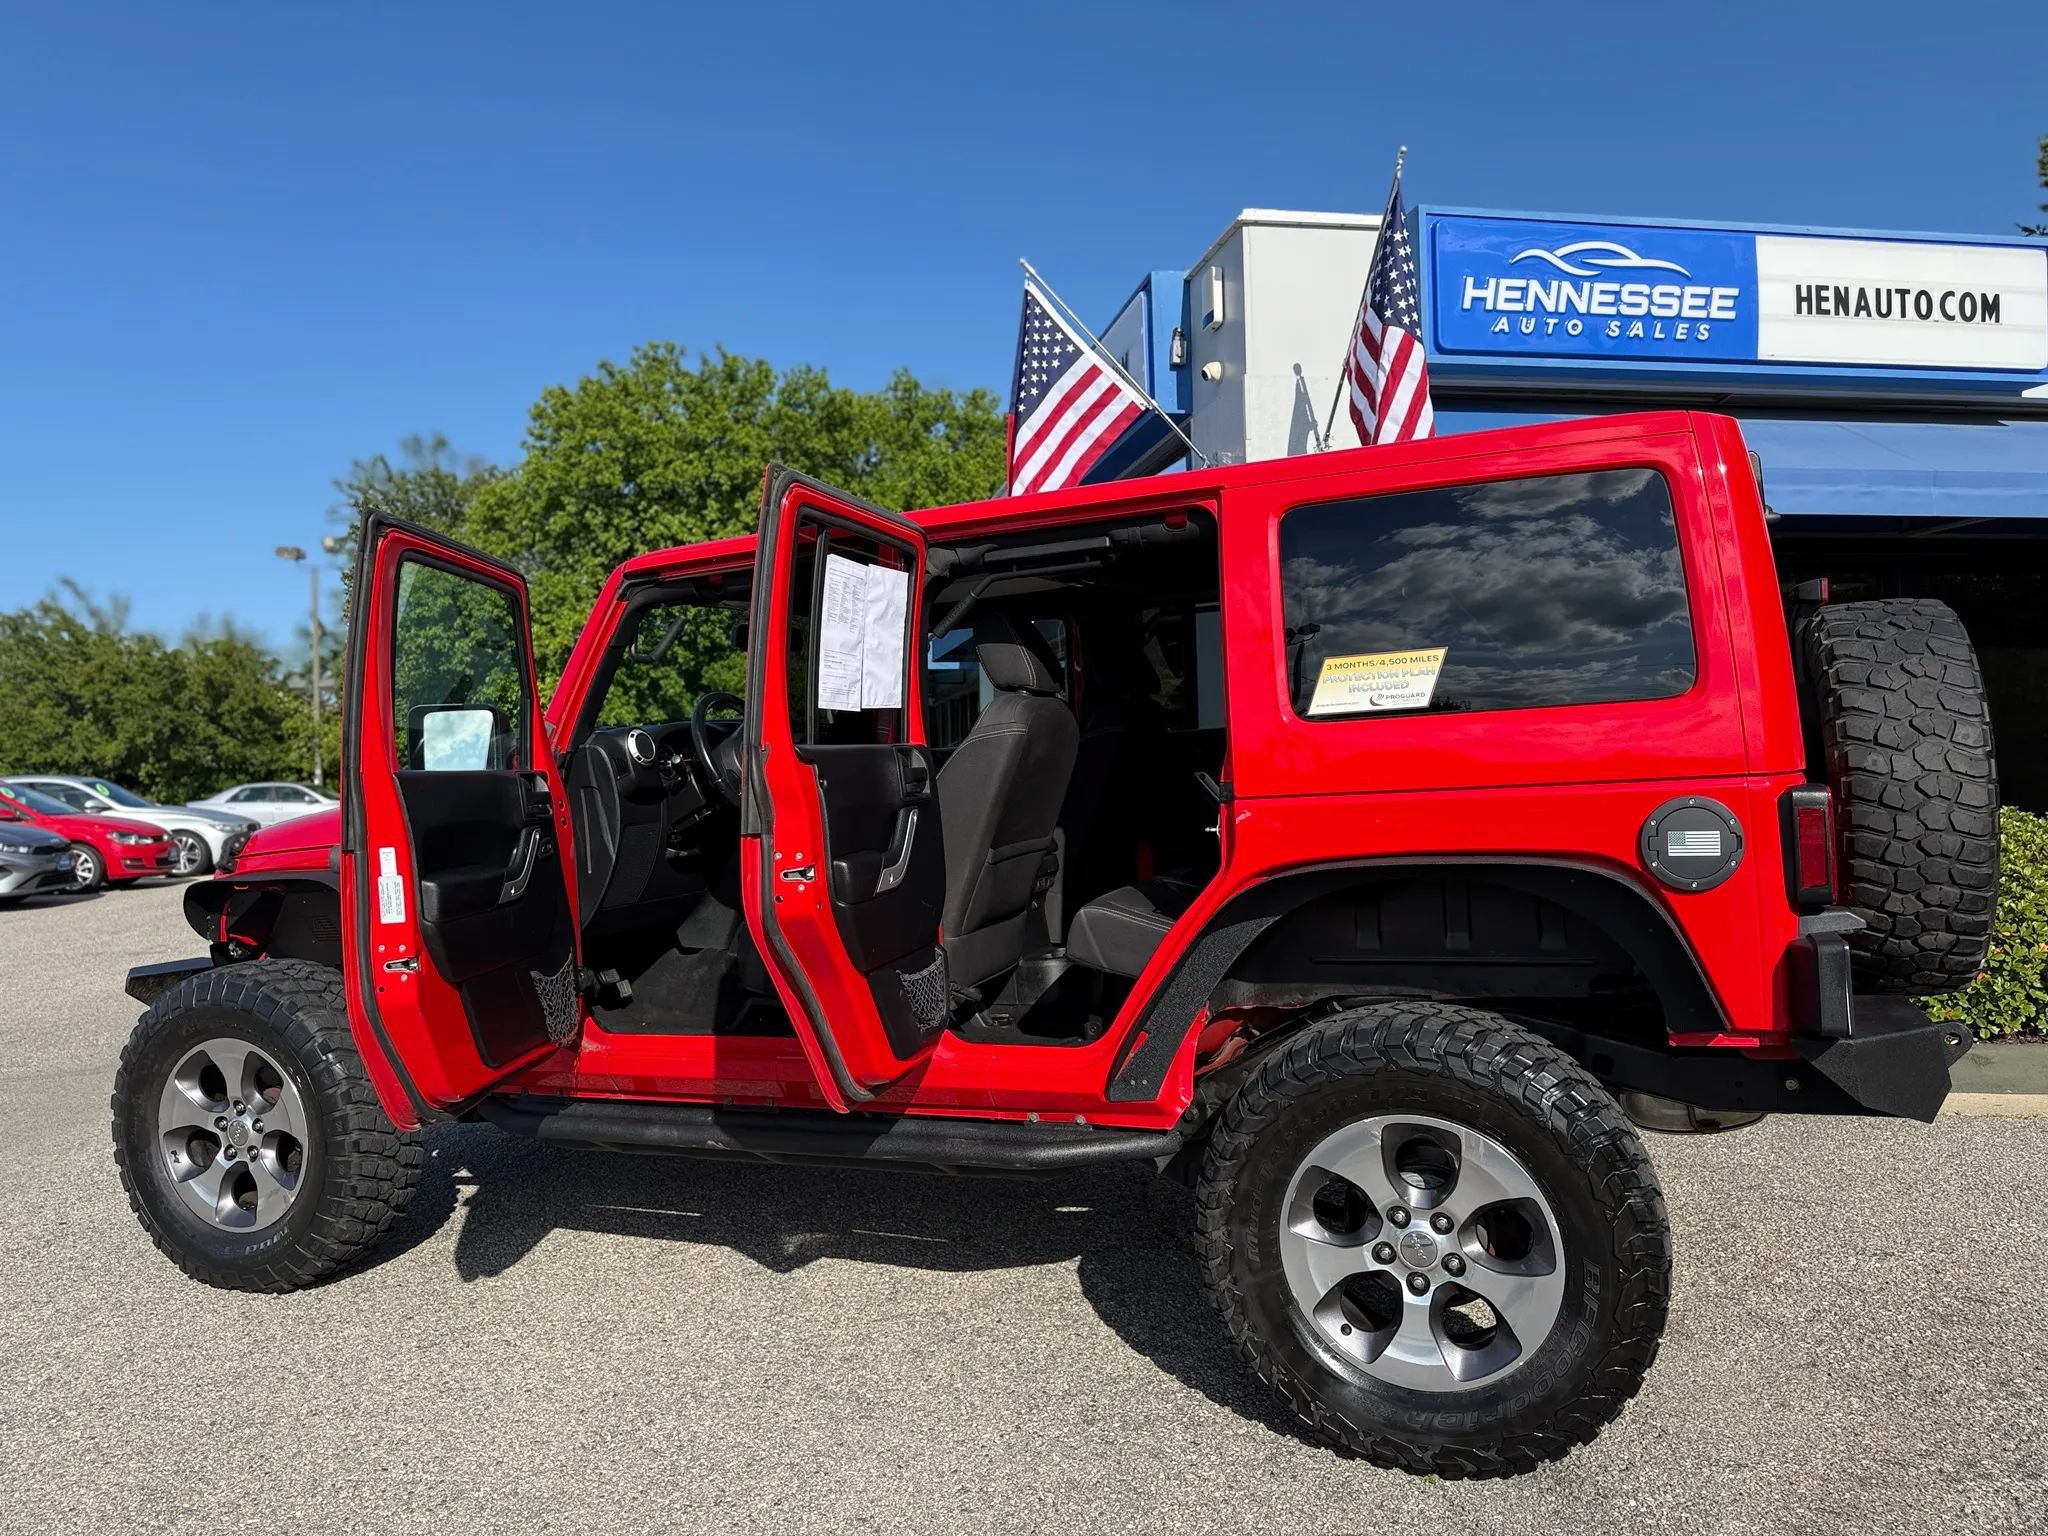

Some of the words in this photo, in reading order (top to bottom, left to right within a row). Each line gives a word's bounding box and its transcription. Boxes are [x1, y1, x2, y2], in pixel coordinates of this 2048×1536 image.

[1461, 275, 1740, 320] HENNESSEE
[1491, 316, 1583, 335] AUTO
[1605, 319, 1711, 341] SALES
[1334, 657, 1408, 670] MONTHS/4,500
[1410, 654, 1439, 664] MILES
[1322, 670, 1399, 684] PROTECTION
[1402, 666, 1436, 677] PLAN
[1348, 680, 1410, 693] INCLUDED
[1385, 692, 1426, 700] PROGUARD
